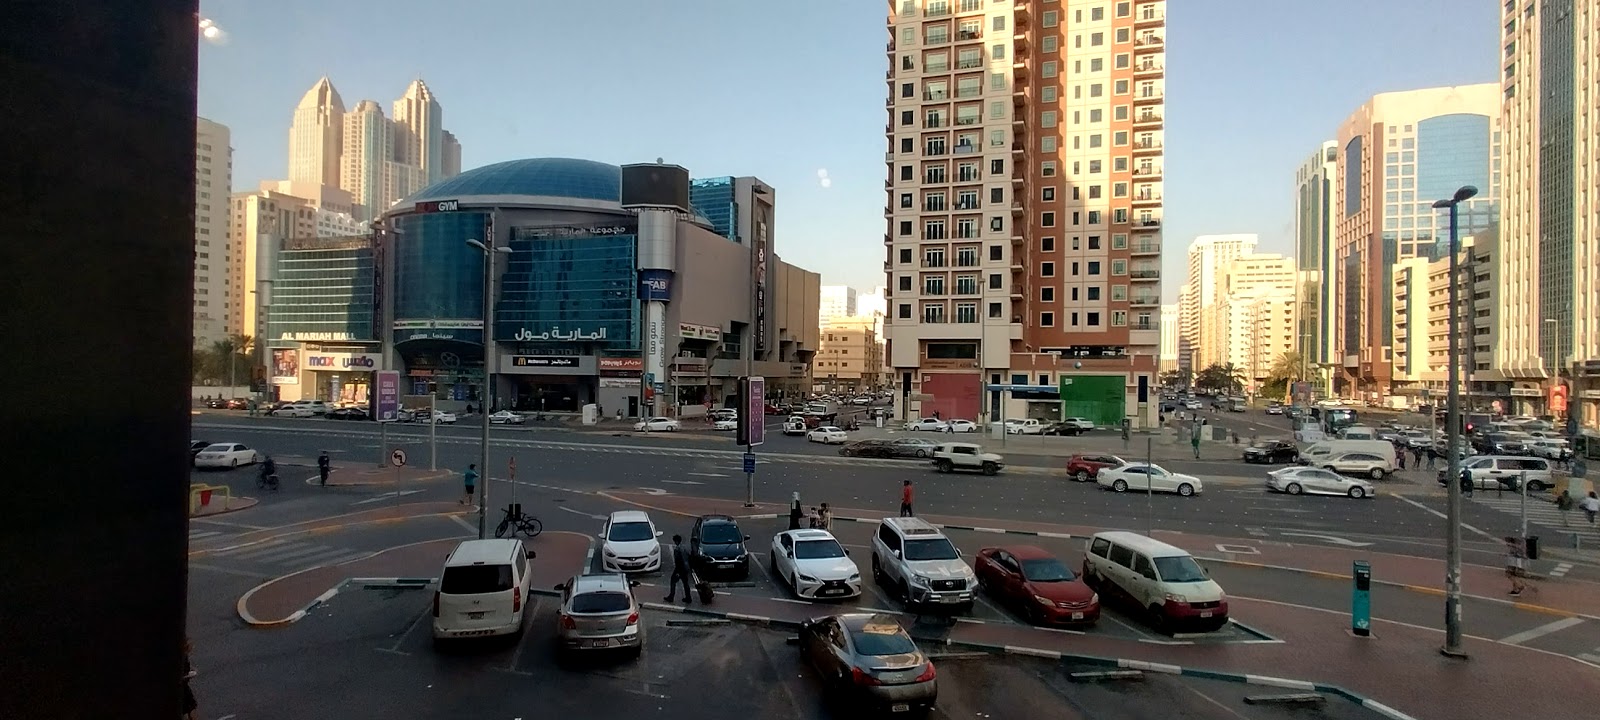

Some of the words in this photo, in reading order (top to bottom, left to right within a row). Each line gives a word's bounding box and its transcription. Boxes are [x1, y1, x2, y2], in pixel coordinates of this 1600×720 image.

[439, 201, 458, 211] GYM
[590, 226, 626, 234] مجموعة
[281, 332, 294, 340] AL
[295, 332, 332, 340] MARIAH
[333, 332, 356, 340] MALL
[514, 327, 549, 341] مول
[551, 326, 607, 341] المارية
[309, 356, 335, 367] max
